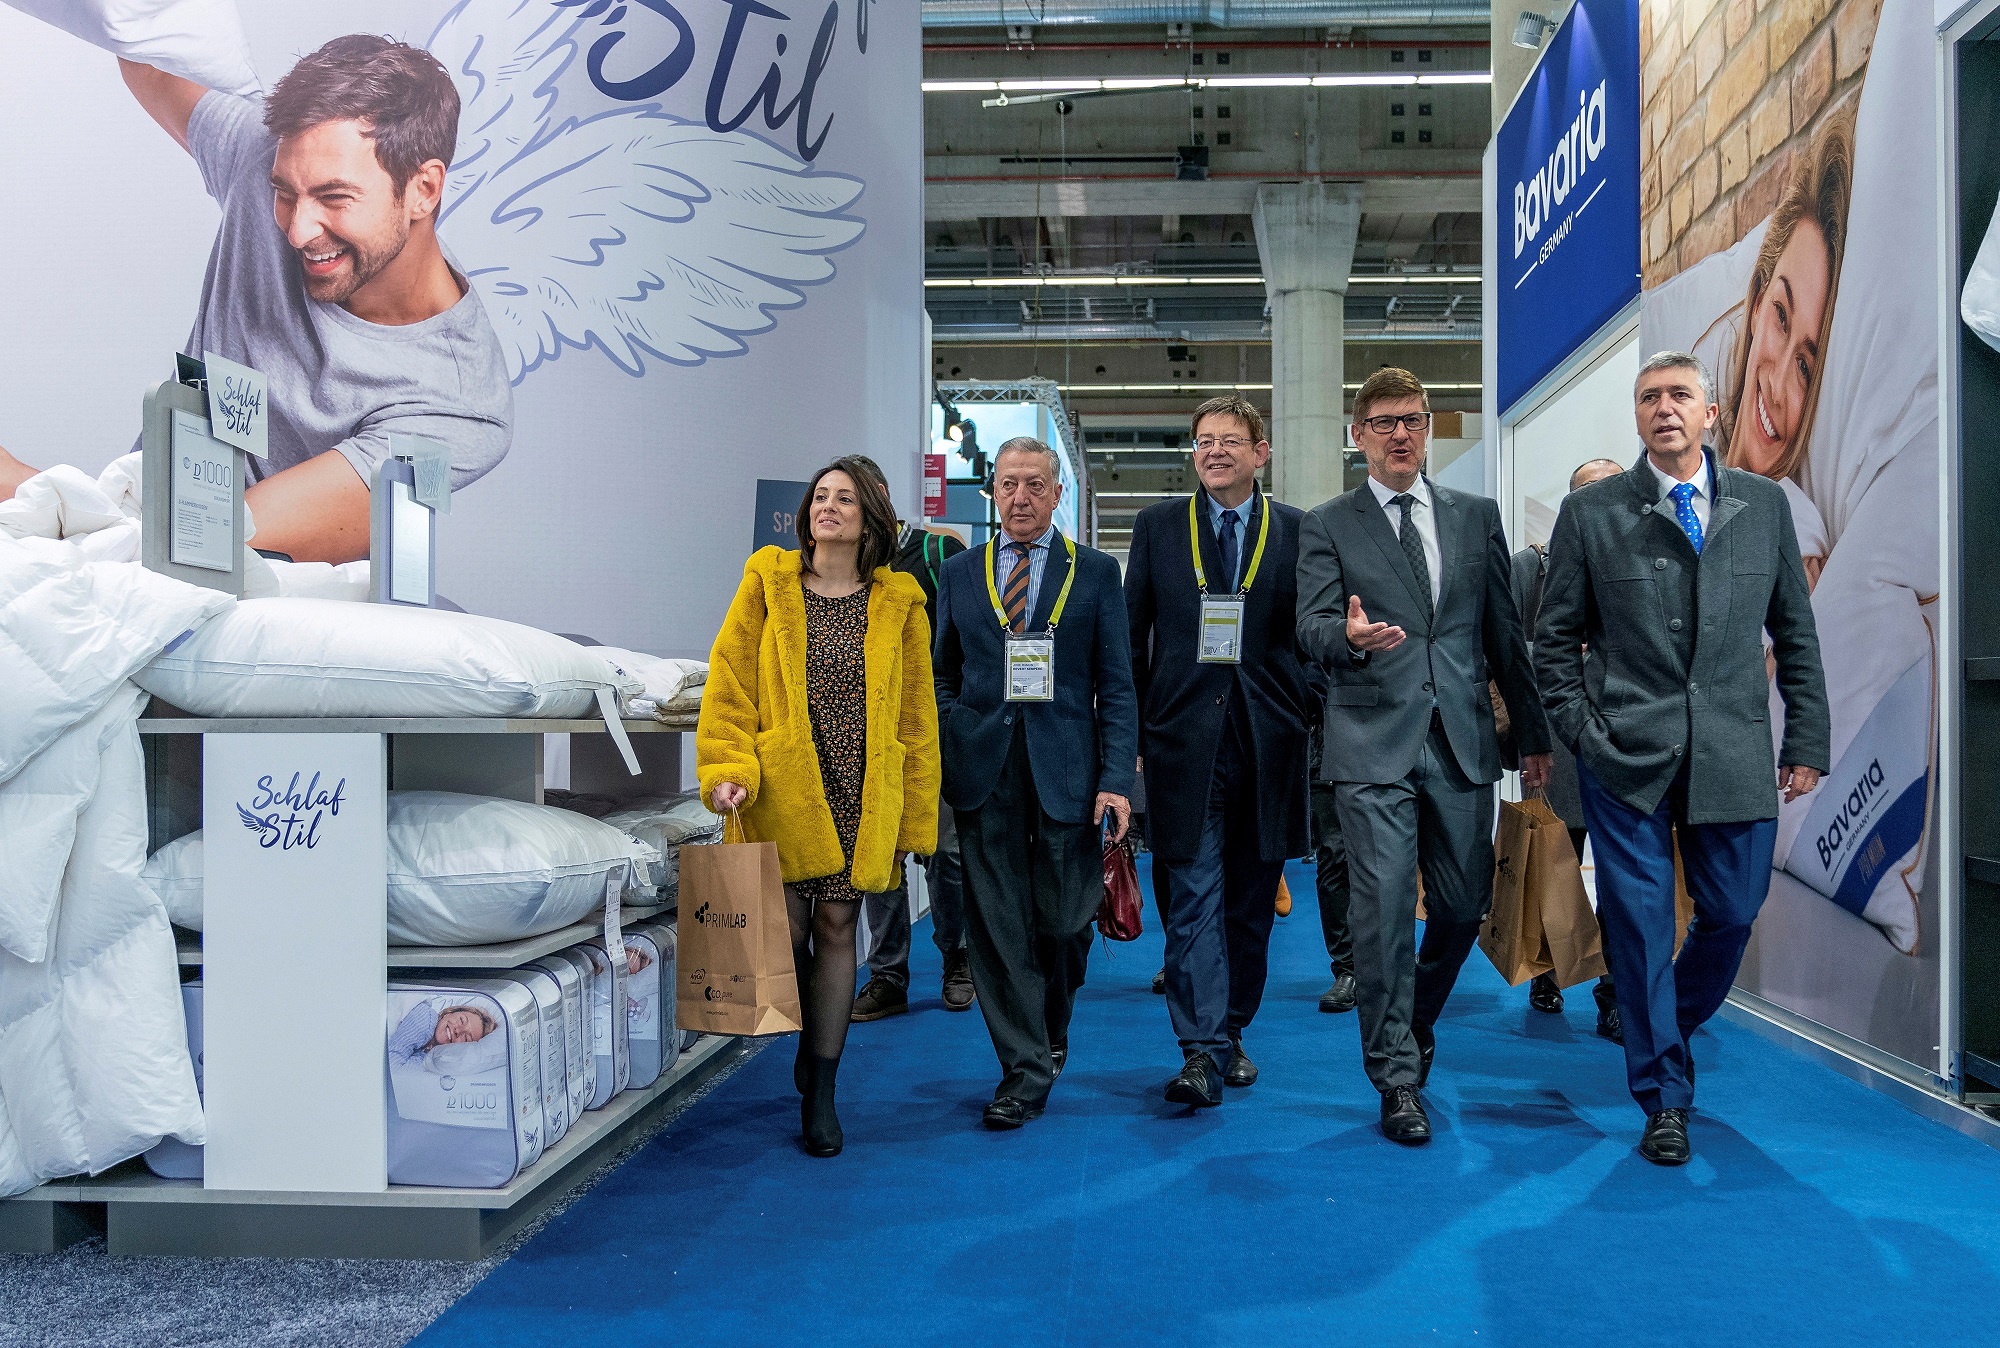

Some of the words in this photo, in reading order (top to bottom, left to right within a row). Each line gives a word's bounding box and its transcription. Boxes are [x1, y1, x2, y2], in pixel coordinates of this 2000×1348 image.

[1515, 78, 1606, 260] Bavaria
[1539, 211, 1574, 265] GERMANY
[224, 376, 261, 415] Schlaf
[227, 405, 252, 436] Stil
[252, 770, 347, 816] Schlaf
[260, 809, 322, 850] Stil
[1815, 757, 1885, 871] Bavaria
[1846, 811, 1870, 852] GERMANY
[705, 913, 747, 929] PRIMLAB
